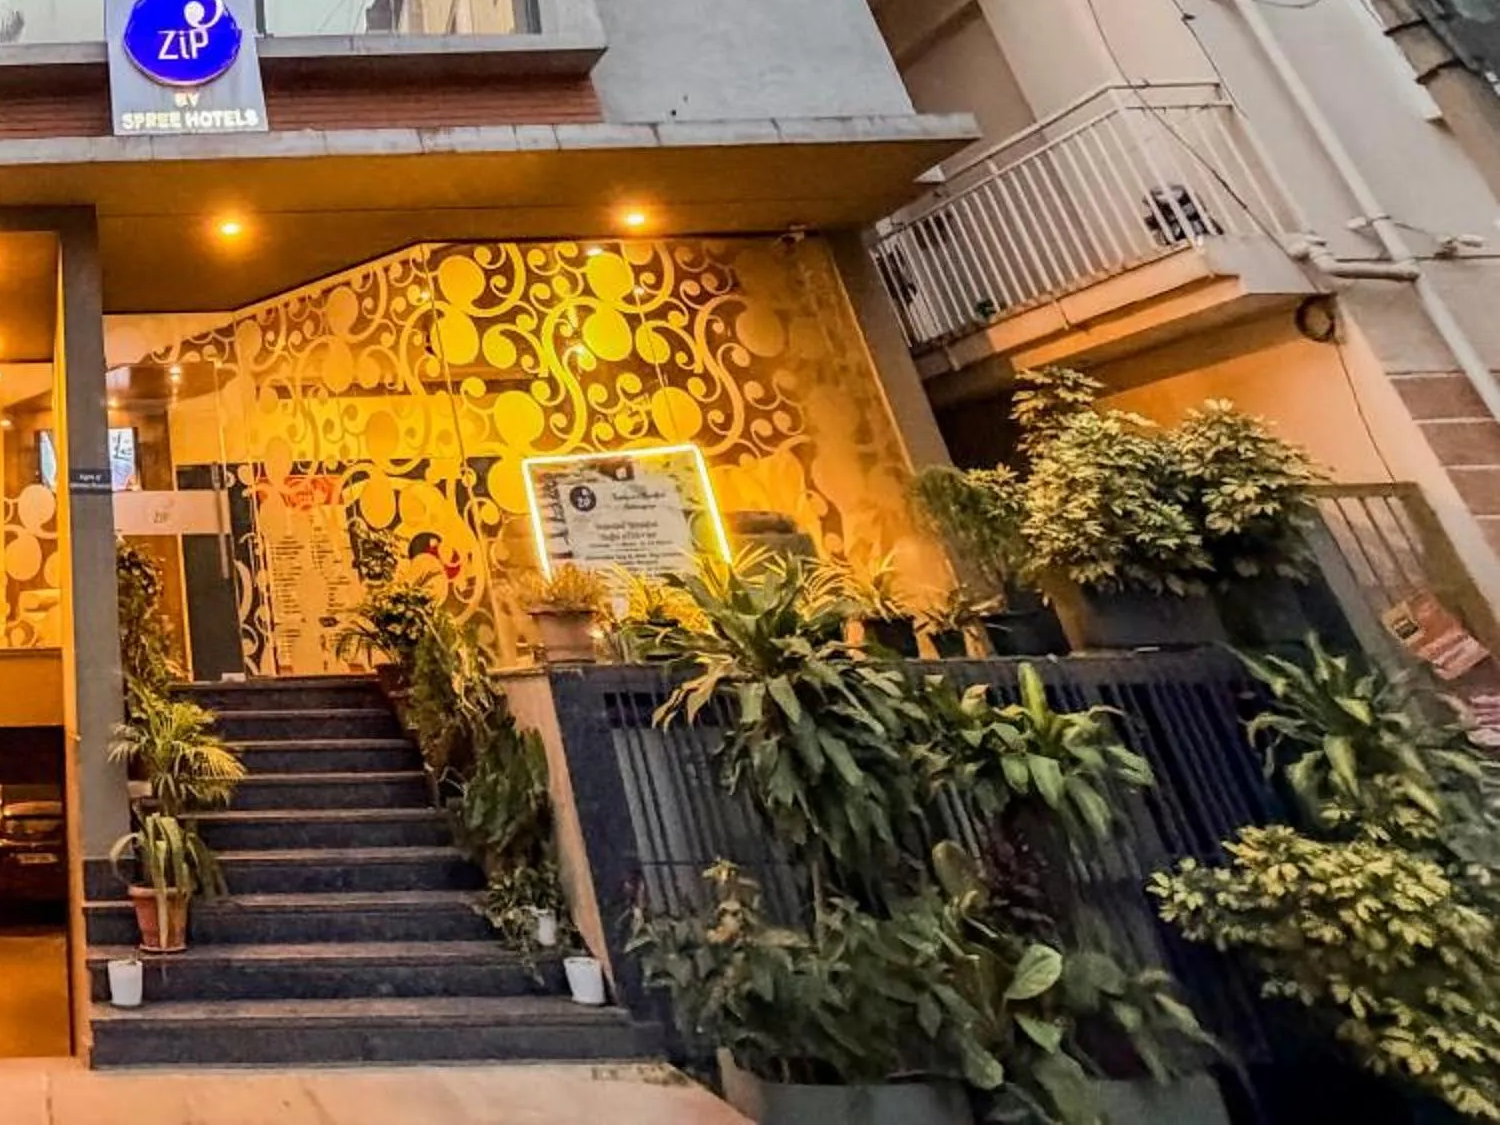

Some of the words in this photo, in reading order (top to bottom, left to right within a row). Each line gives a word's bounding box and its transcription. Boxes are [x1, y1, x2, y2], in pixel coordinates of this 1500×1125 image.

[174, 92, 200, 107] BY
[122, 110, 181, 130] SPREE
[184, 108, 259, 128] HOTELS
